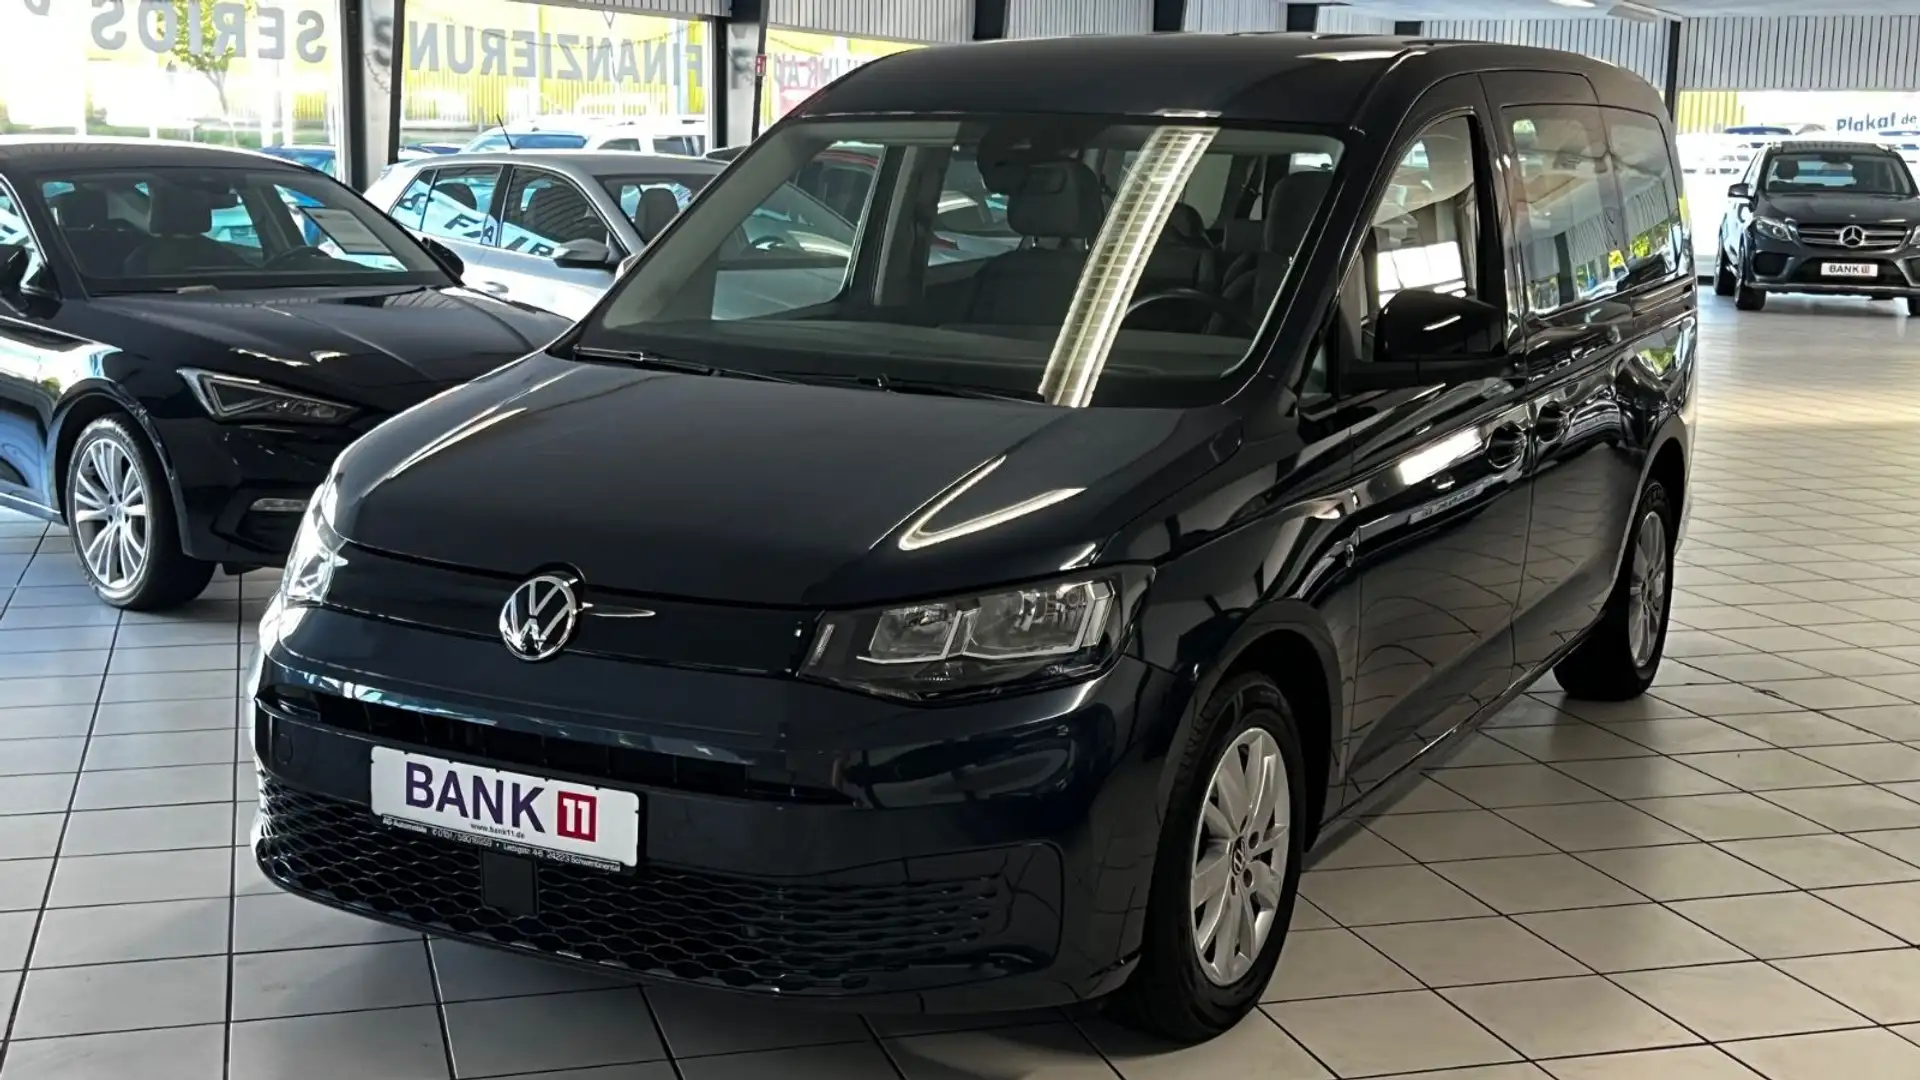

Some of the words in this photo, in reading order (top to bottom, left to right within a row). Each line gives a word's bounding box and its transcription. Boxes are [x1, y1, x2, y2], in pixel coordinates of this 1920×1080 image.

[1828, 264, 1859, 274] BANK
[405, 761, 546, 834] BANK
[560, 795, 593, 838] 11
[470, 821, 526, 840] www.bank11.de
